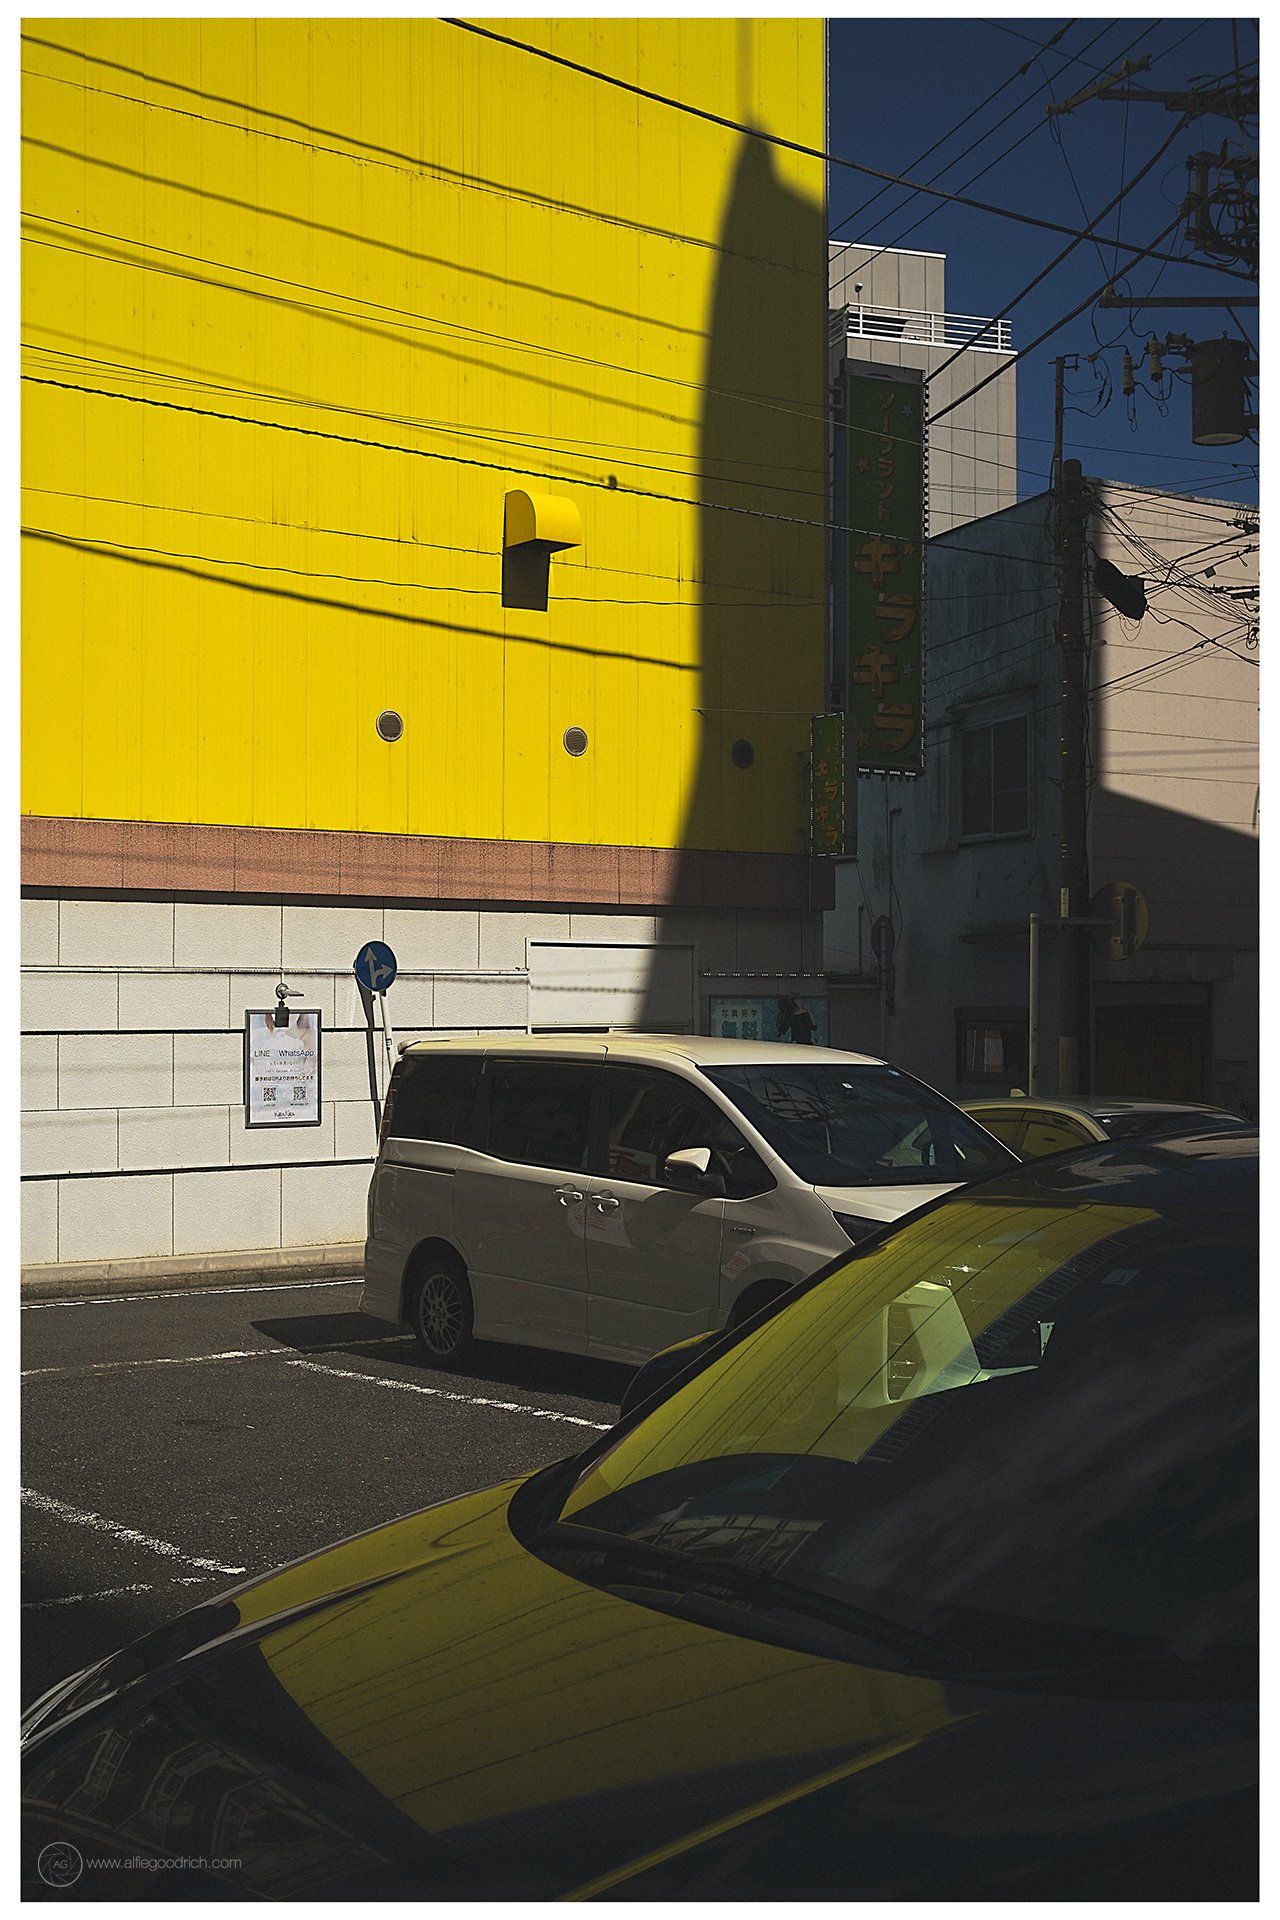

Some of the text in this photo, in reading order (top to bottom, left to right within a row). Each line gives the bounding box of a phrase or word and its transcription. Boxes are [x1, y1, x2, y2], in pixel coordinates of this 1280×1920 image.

[721, 1009, 758, 1018] 写真見学
[254, 1049, 315, 1057] LINE WhatsApp
